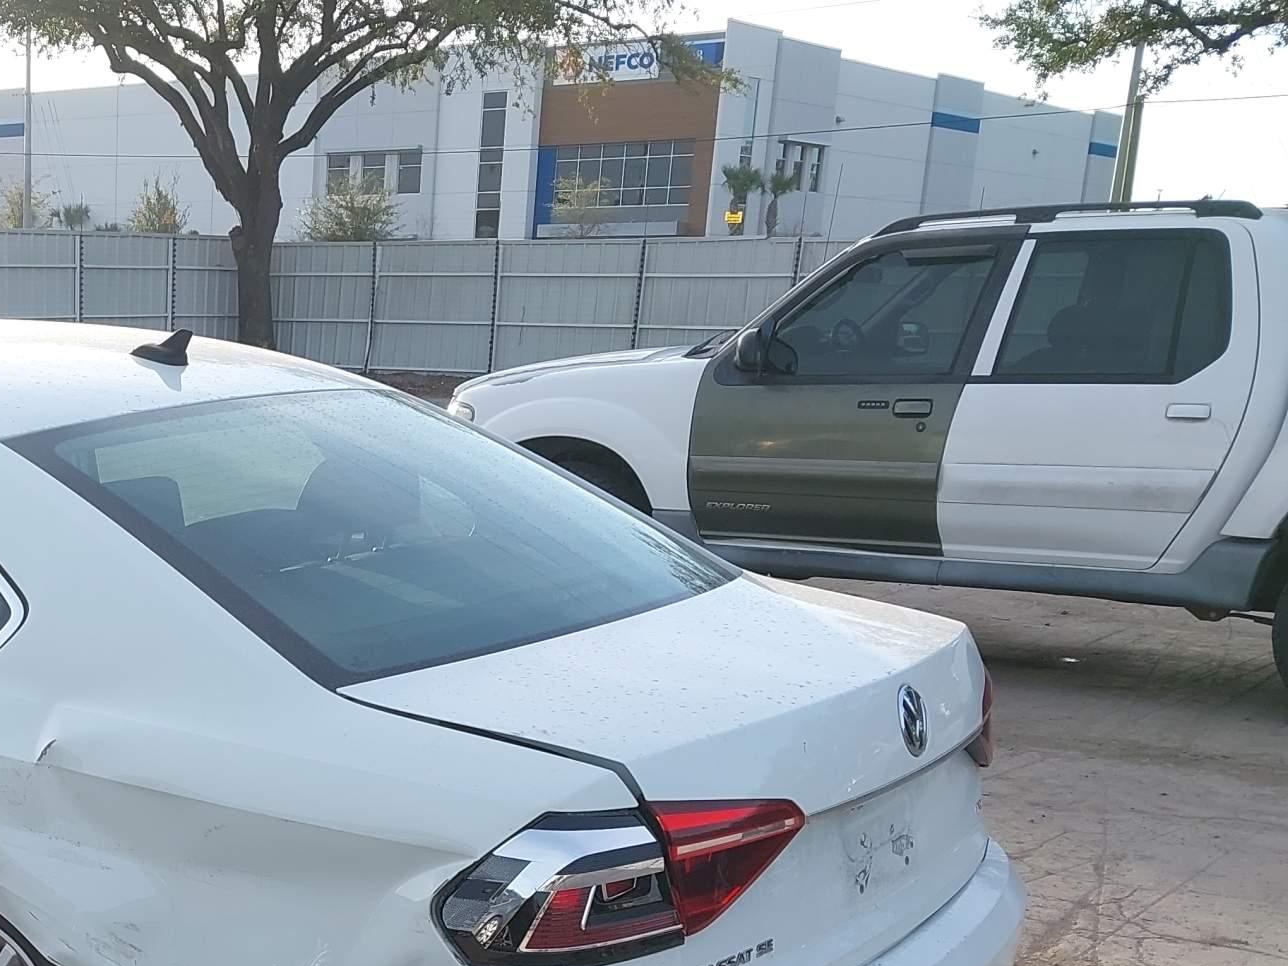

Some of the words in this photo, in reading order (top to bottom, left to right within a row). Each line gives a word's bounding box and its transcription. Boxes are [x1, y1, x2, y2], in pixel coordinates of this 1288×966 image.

[589, 52, 655, 73] NEFCO
[705, 501, 772, 512] EXPLORER
[755, 938, 774, 958] SE
